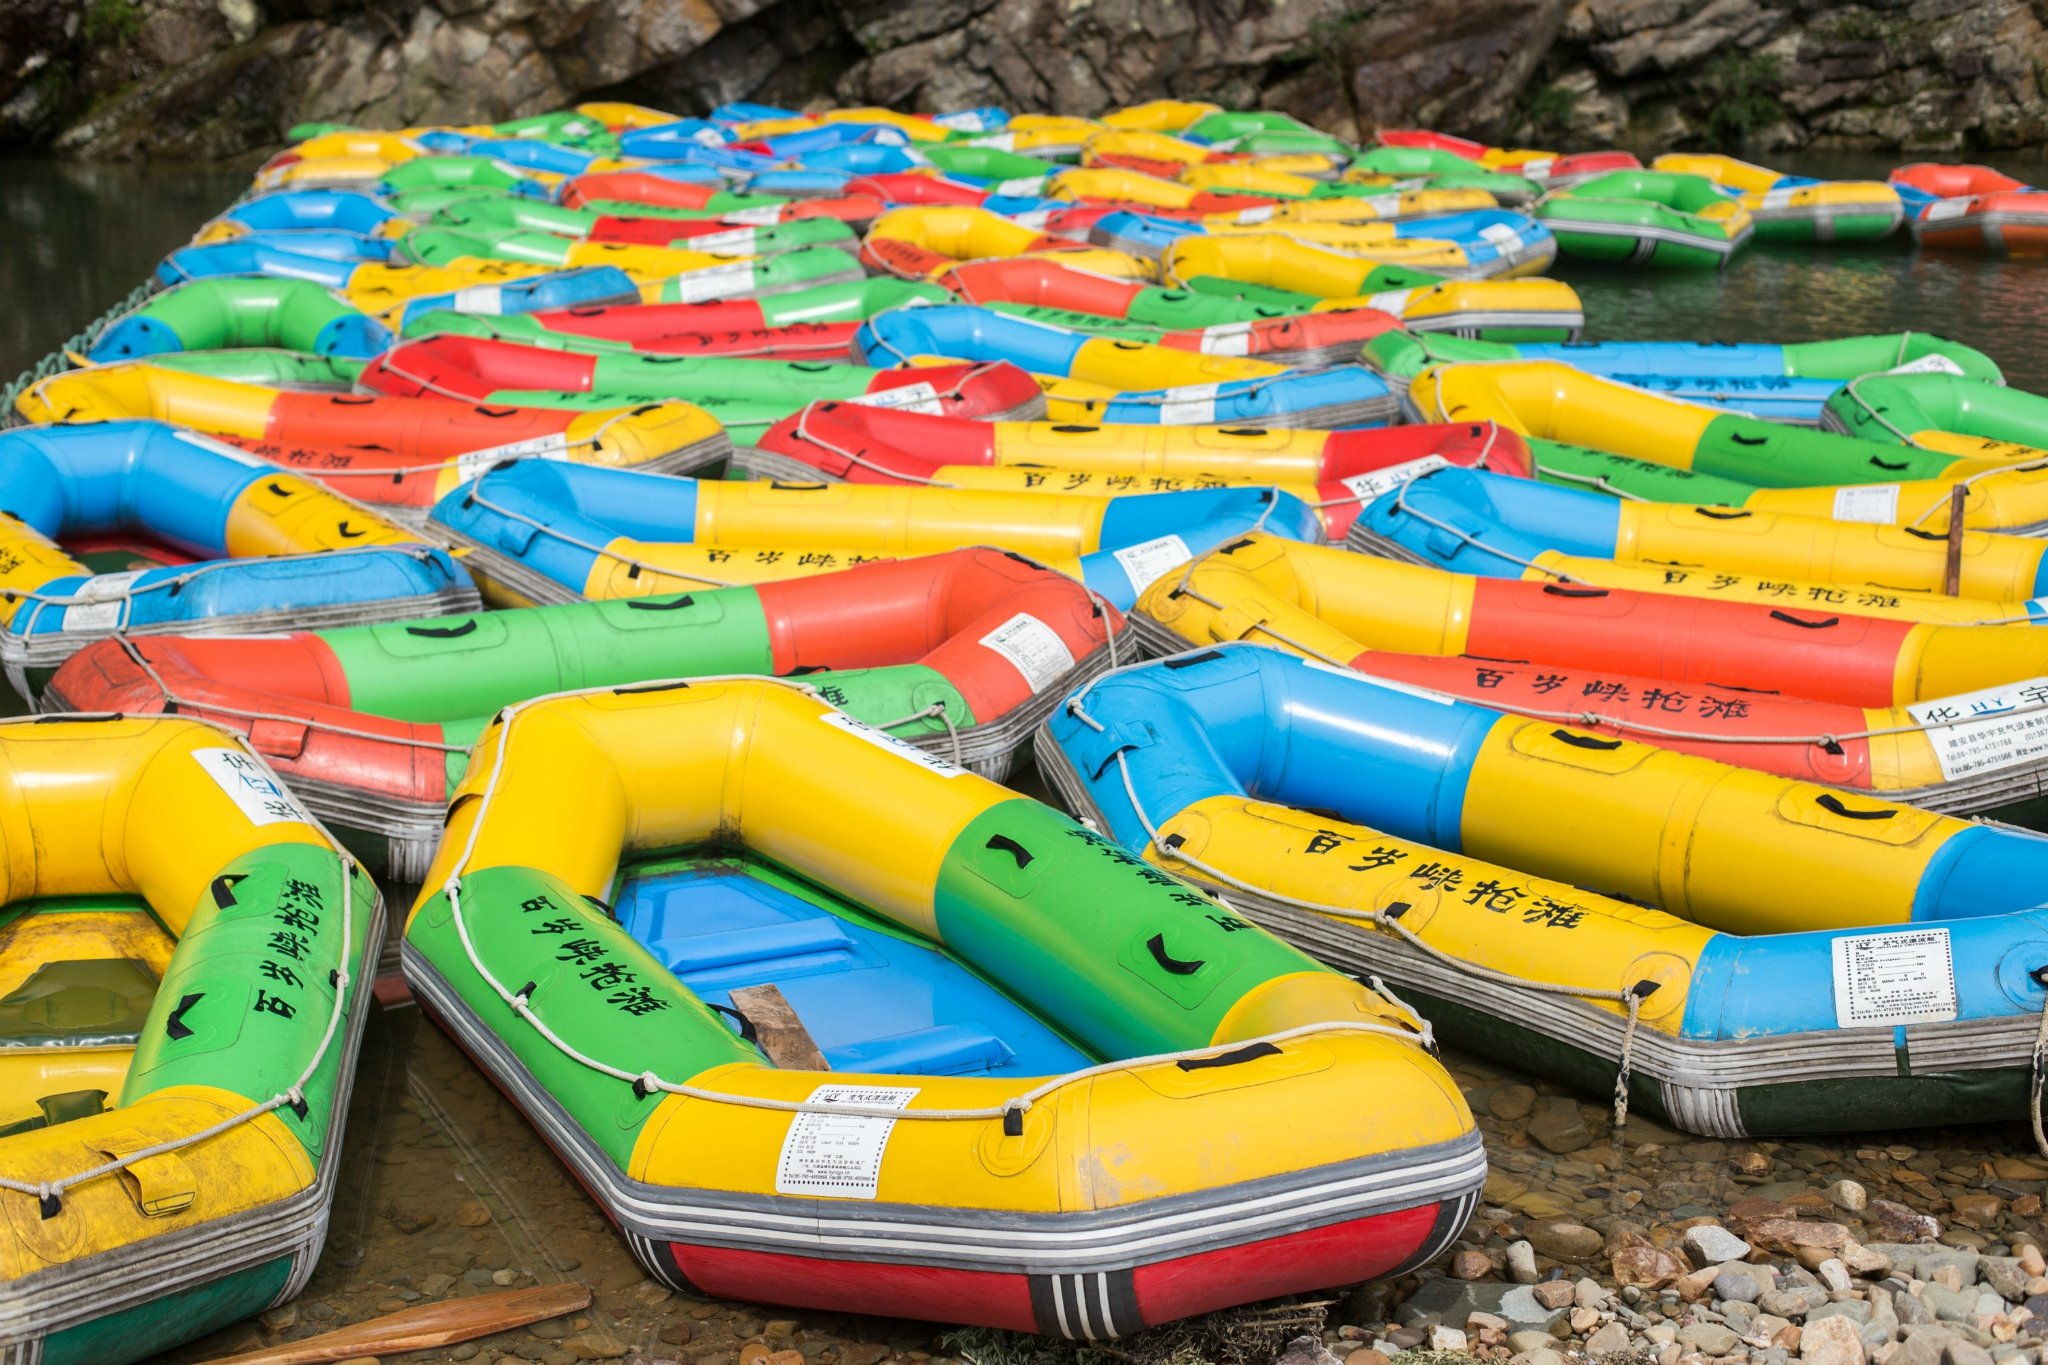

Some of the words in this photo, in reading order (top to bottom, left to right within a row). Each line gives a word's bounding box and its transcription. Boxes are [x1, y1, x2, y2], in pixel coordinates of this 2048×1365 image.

[1476, 668, 1752, 719] 百岁峡抢滩
[1304, 828, 1590, 930] 百岁峡抢滩
[252, 878, 325, 1020] 百岁峡抢滩
[520, 895, 673, 1017] 百岁峡抢滩
